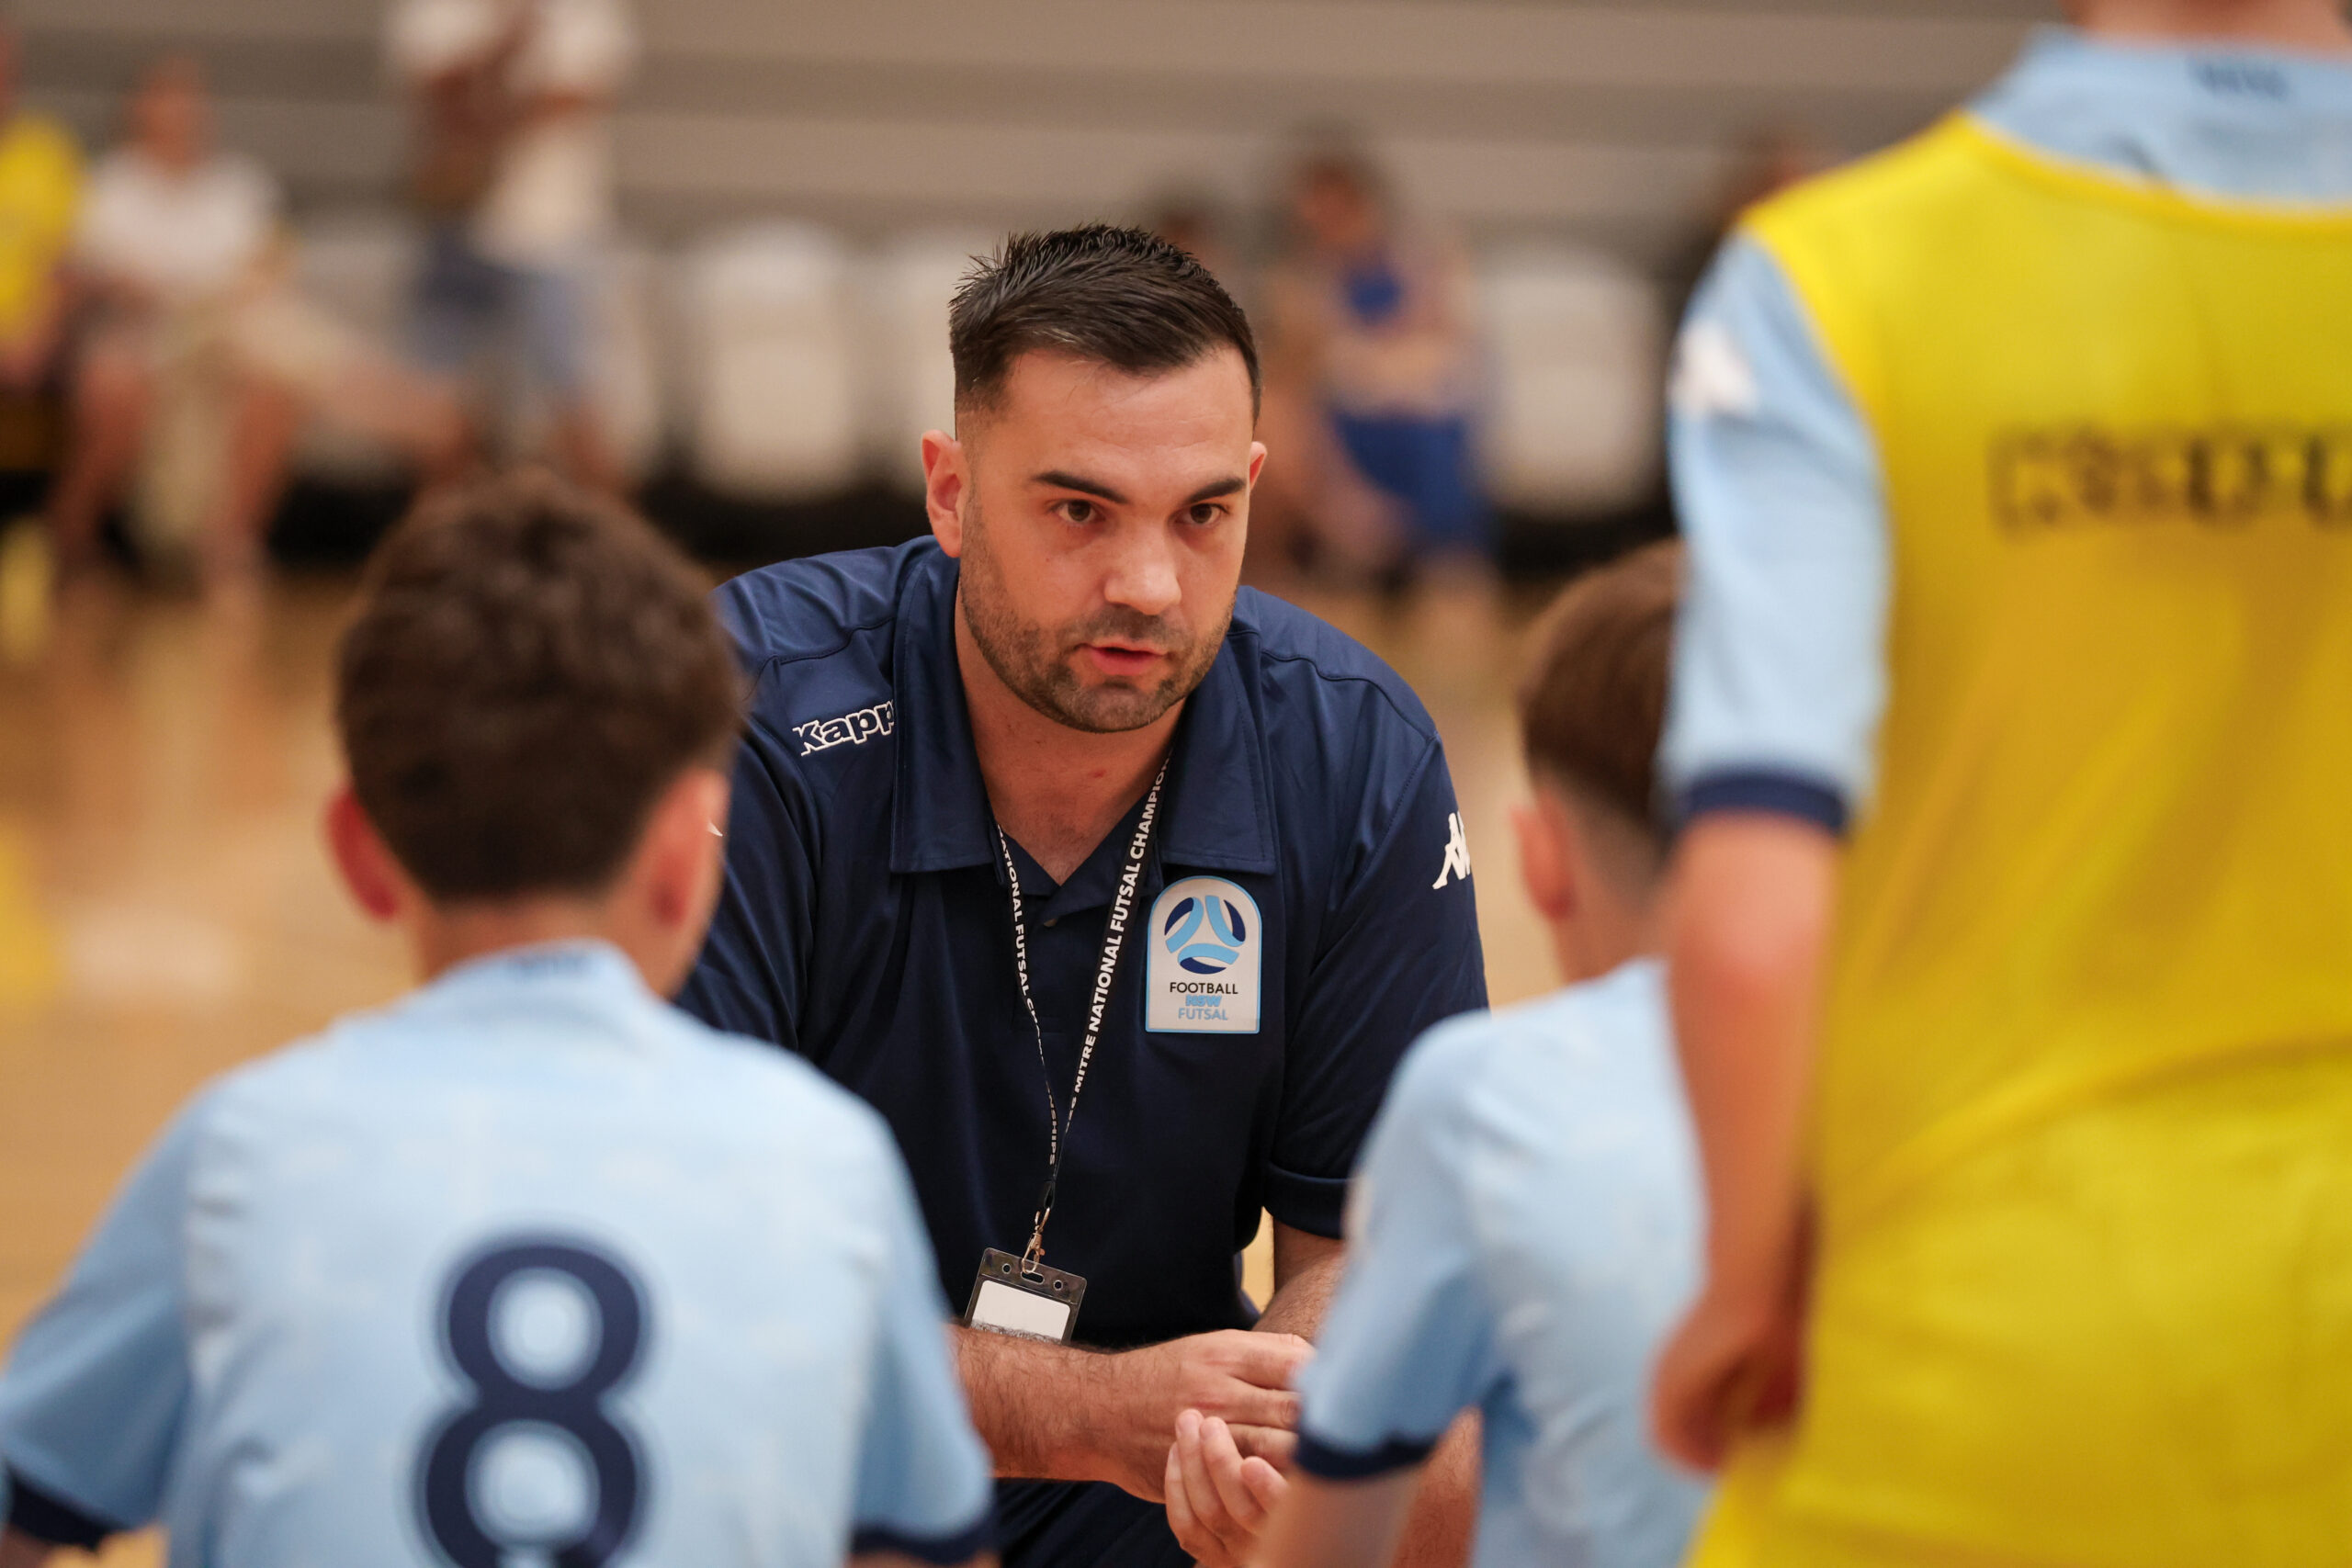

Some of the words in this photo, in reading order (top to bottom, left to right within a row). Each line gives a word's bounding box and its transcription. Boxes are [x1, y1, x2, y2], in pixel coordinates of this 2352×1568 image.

[1015, 924, 1030, 996] FUTSAL
[1074, 1034, 1096, 1093] MITRE
[1088, 935, 1123, 1032] NATIONAL
[1110, 863, 1141, 932] FUTSAL
[1170, 982, 1238, 995] FOOTBALL
[1185, 995, 1222, 1008] NSW
[1178, 1008, 1228, 1021] FUTSAL
[413, 1233, 650, 1568] 8
